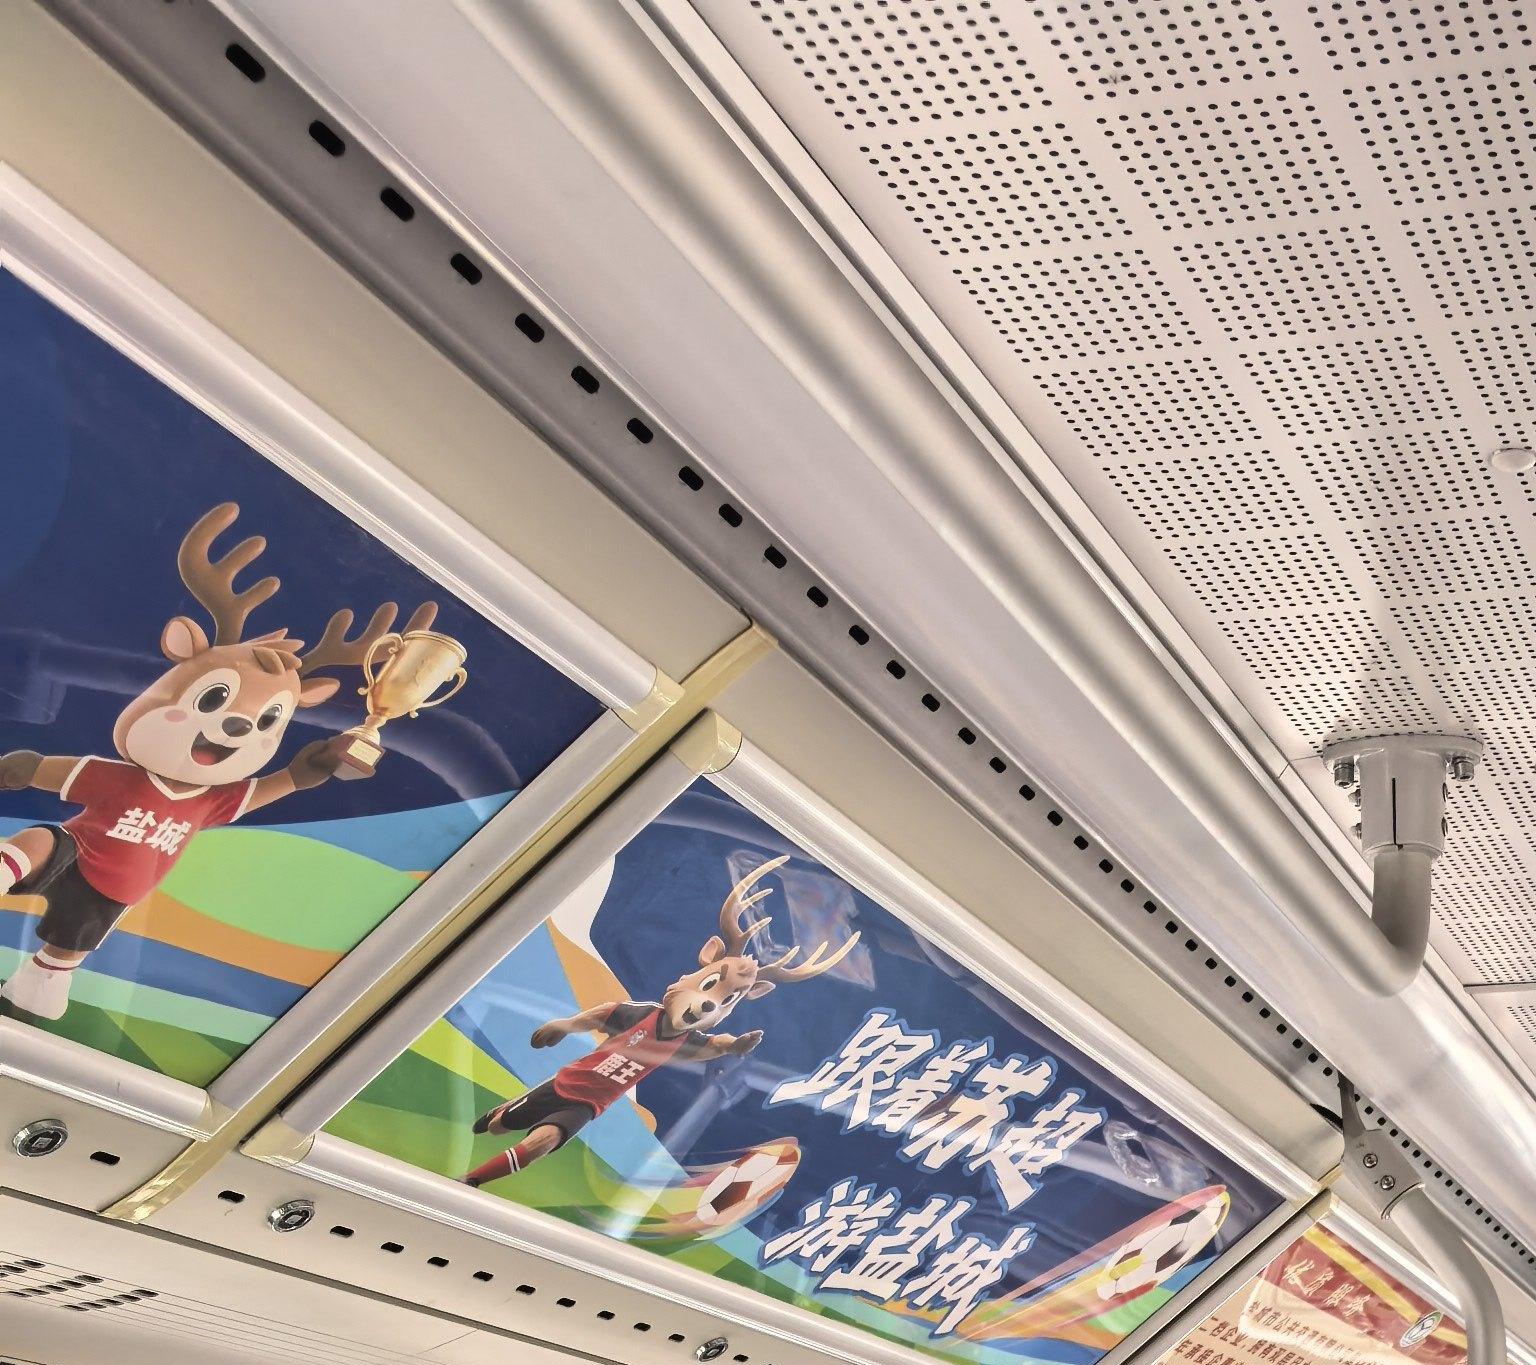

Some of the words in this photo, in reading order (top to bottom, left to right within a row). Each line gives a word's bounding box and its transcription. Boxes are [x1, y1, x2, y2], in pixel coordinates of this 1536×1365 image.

[105, 807, 192, 855] 盐城
[773, 1011, 1104, 1212] 跟着苏超
[763, 1181, 1034, 1336] 游盐城
